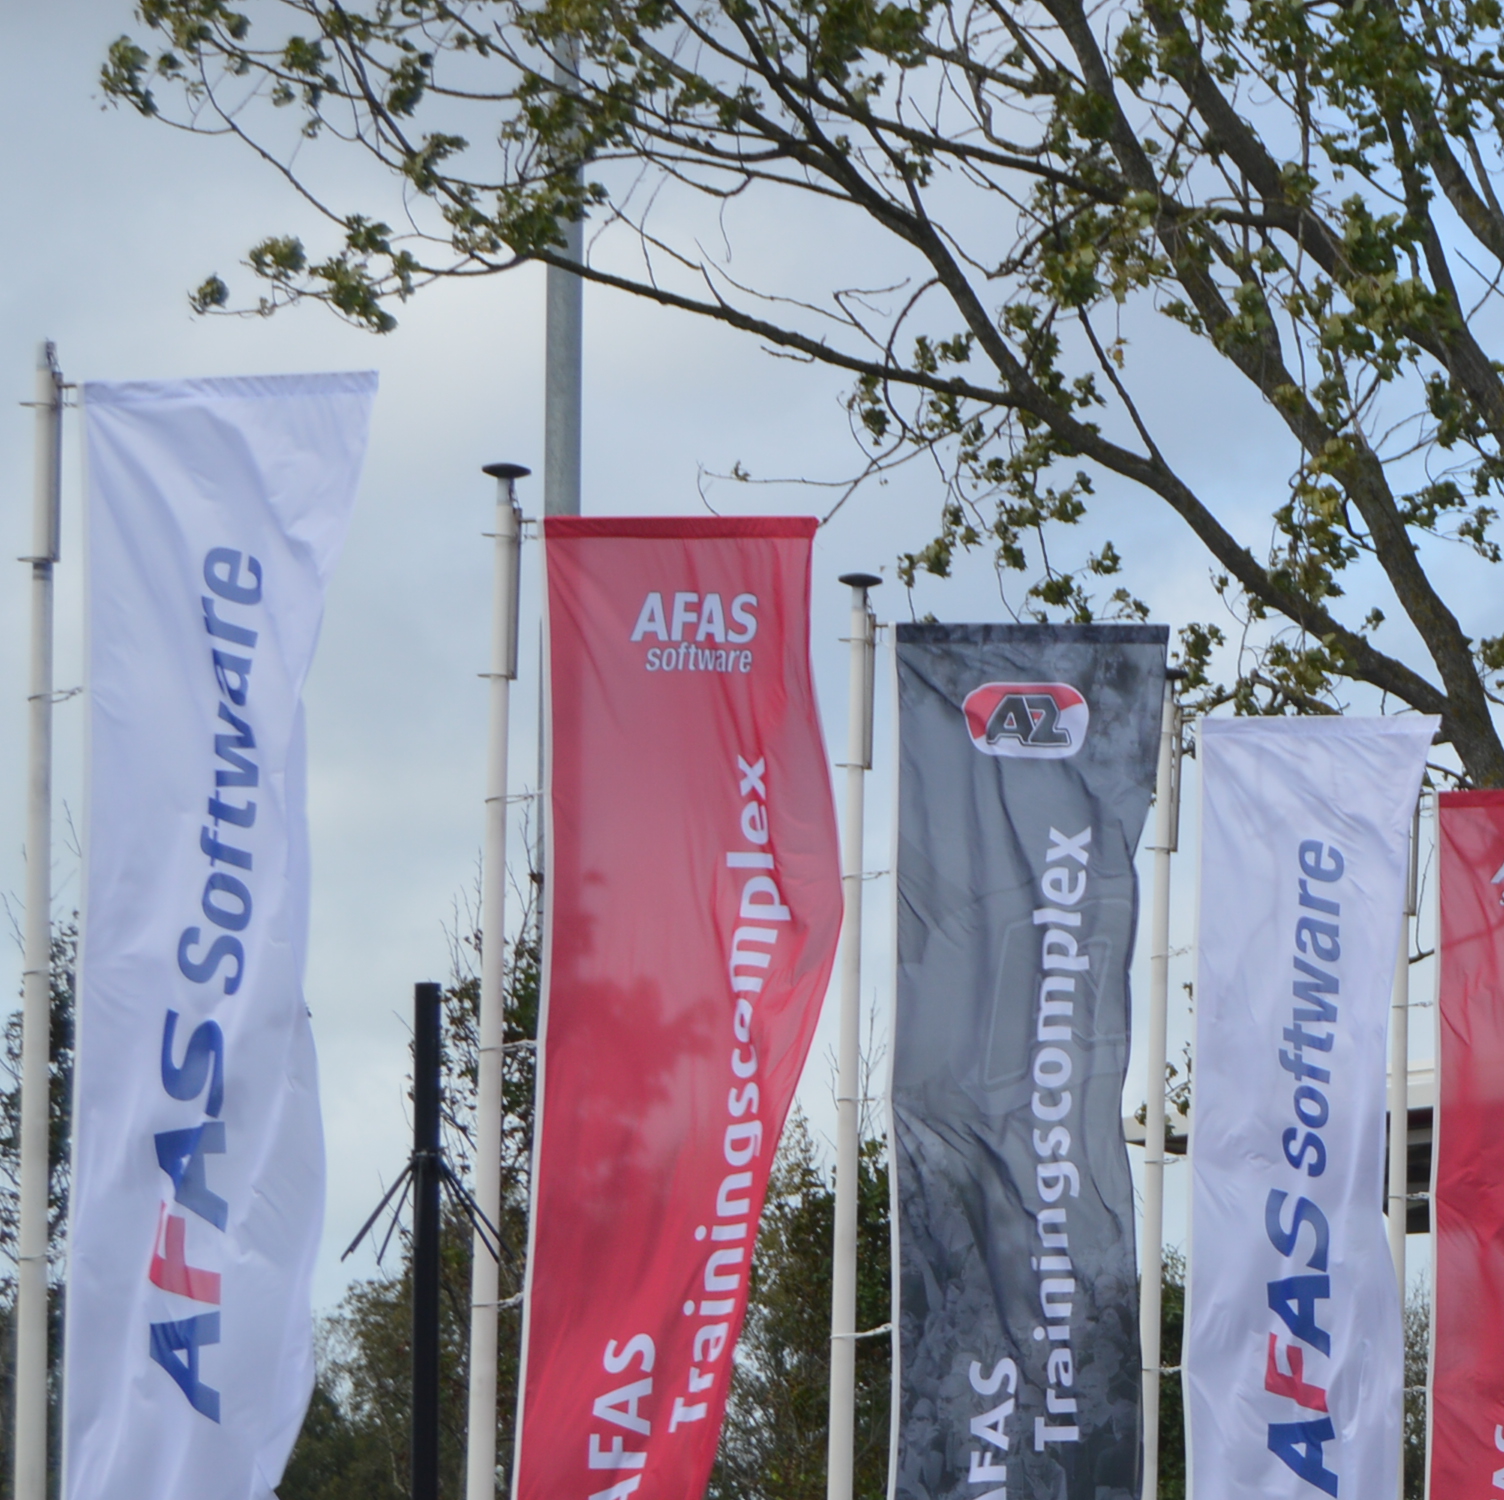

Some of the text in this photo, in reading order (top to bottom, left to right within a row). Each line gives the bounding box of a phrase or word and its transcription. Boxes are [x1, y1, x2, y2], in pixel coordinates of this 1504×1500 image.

[630, 592, 759, 643] AFAS
[645, 643, 753, 673] software
[986, 692, 1073, 748] AZ
[148, 546, 264, 1424] AFAS Software
[668, 755, 791, 1433] Trainingscomplex
[1032, 826, 1092, 1452] Trainingscomplex
[1264, 838, 1345, 1499] AFAS Software
